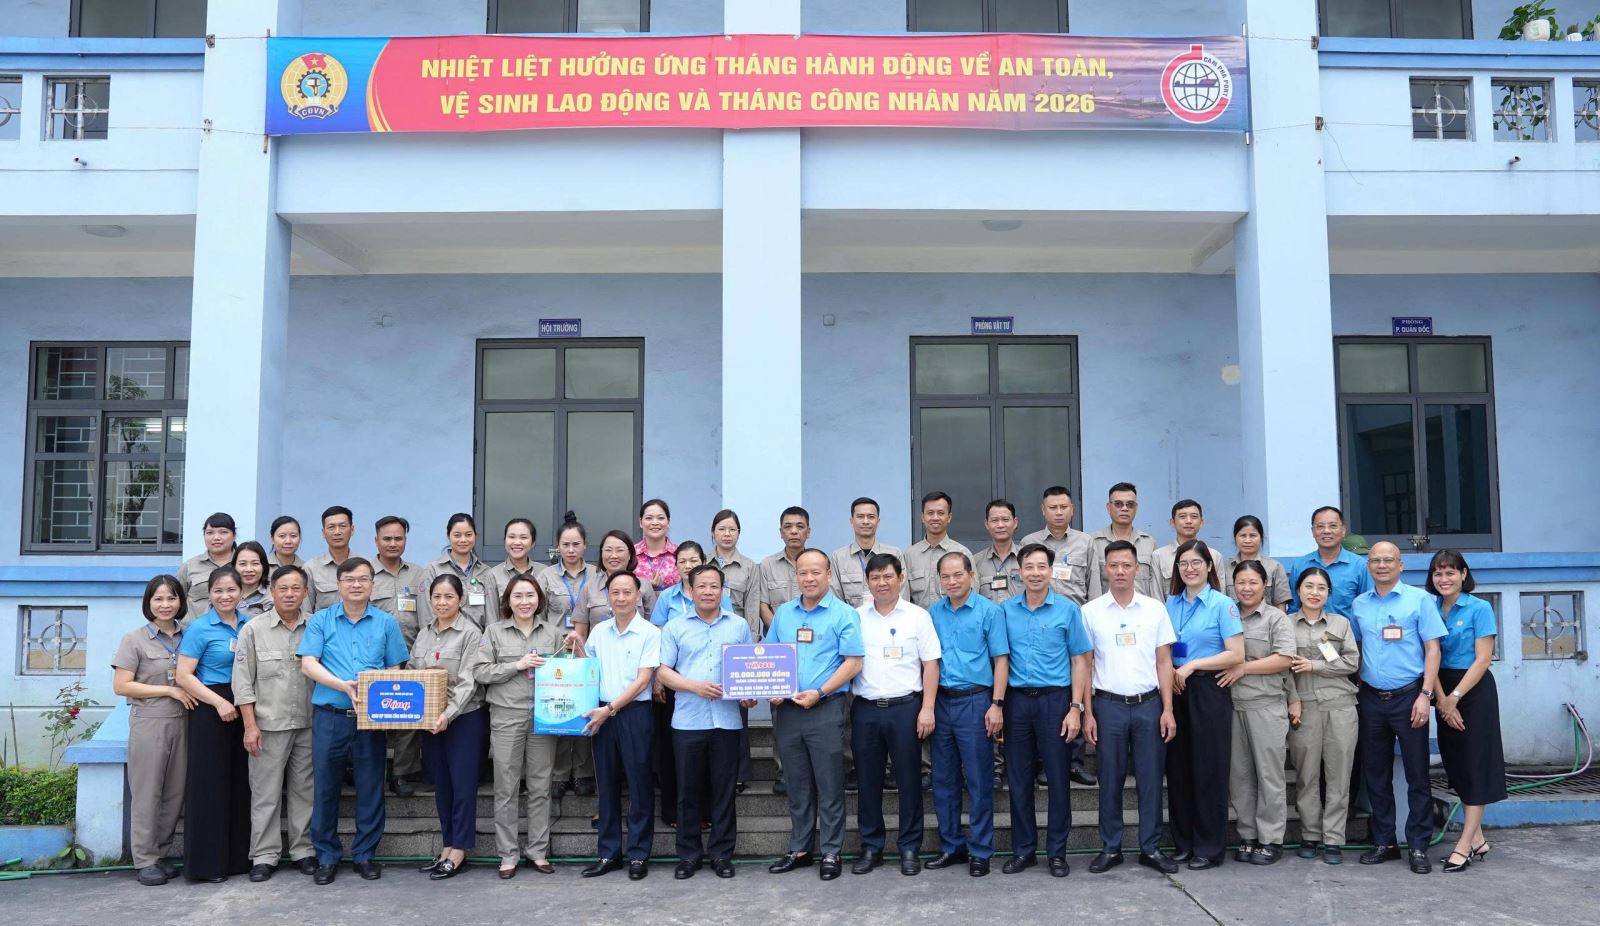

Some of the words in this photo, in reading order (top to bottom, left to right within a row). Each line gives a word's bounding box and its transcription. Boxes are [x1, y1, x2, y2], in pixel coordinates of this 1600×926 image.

[421, 55, 494, 82] NHIỆT
[501, 54, 552, 81] LIỆT
[560, 51, 646, 77] HƯỞNG
[654, 53, 706, 76] ỨNG
[715, 52, 797, 75] THÁNG
[805, 52, 875, 75] HÀNH
[882, 52, 952, 80] ĐỘNG
[960, 51, 991, 76] VỀ
[998, 57, 1033, 76] AN
[1041, 53, 1114, 80] TOÀN,
[440, 90, 470, 118] VỆ
[478, 94, 538, 114] SINH
[546, 93, 592, 113] LAO
[600, 88, 670, 116] ĐỘNG
[678, 87, 711, 111] VÀ
[718, 87, 802, 111] THÁNG
[810, 87, 880, 111] CÔNG
[888, 88, 960, 111] NHÂN
[967, 88, 1027, 112] NĂM
[1034, 93, 1096, 113] 2026
[542, 323, 551, 335] HỘI
[553, 322, 578, 332] TRƯỜNG
